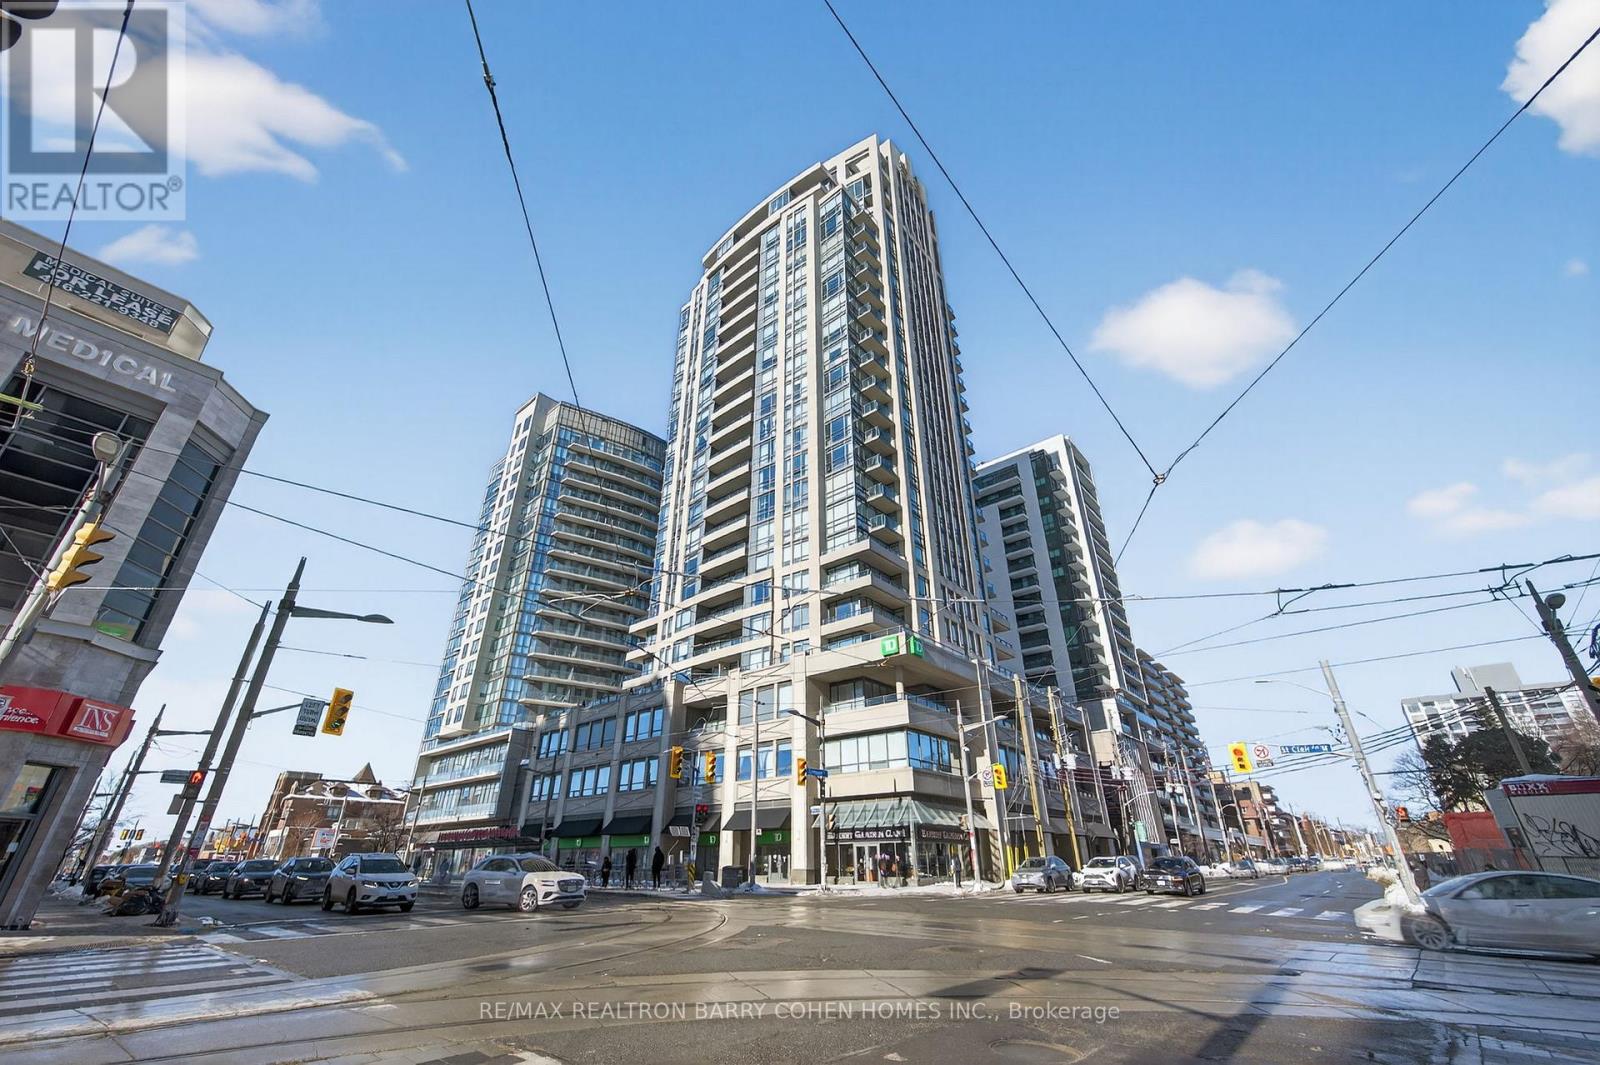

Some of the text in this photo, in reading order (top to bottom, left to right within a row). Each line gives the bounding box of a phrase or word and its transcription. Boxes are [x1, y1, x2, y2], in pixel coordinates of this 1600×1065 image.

[33, 260, 174, 326] FOR LEASE
[44, 256, 172, 316] MEDICAL SUITES
[12, 317, 177, 393] MEDICAL
